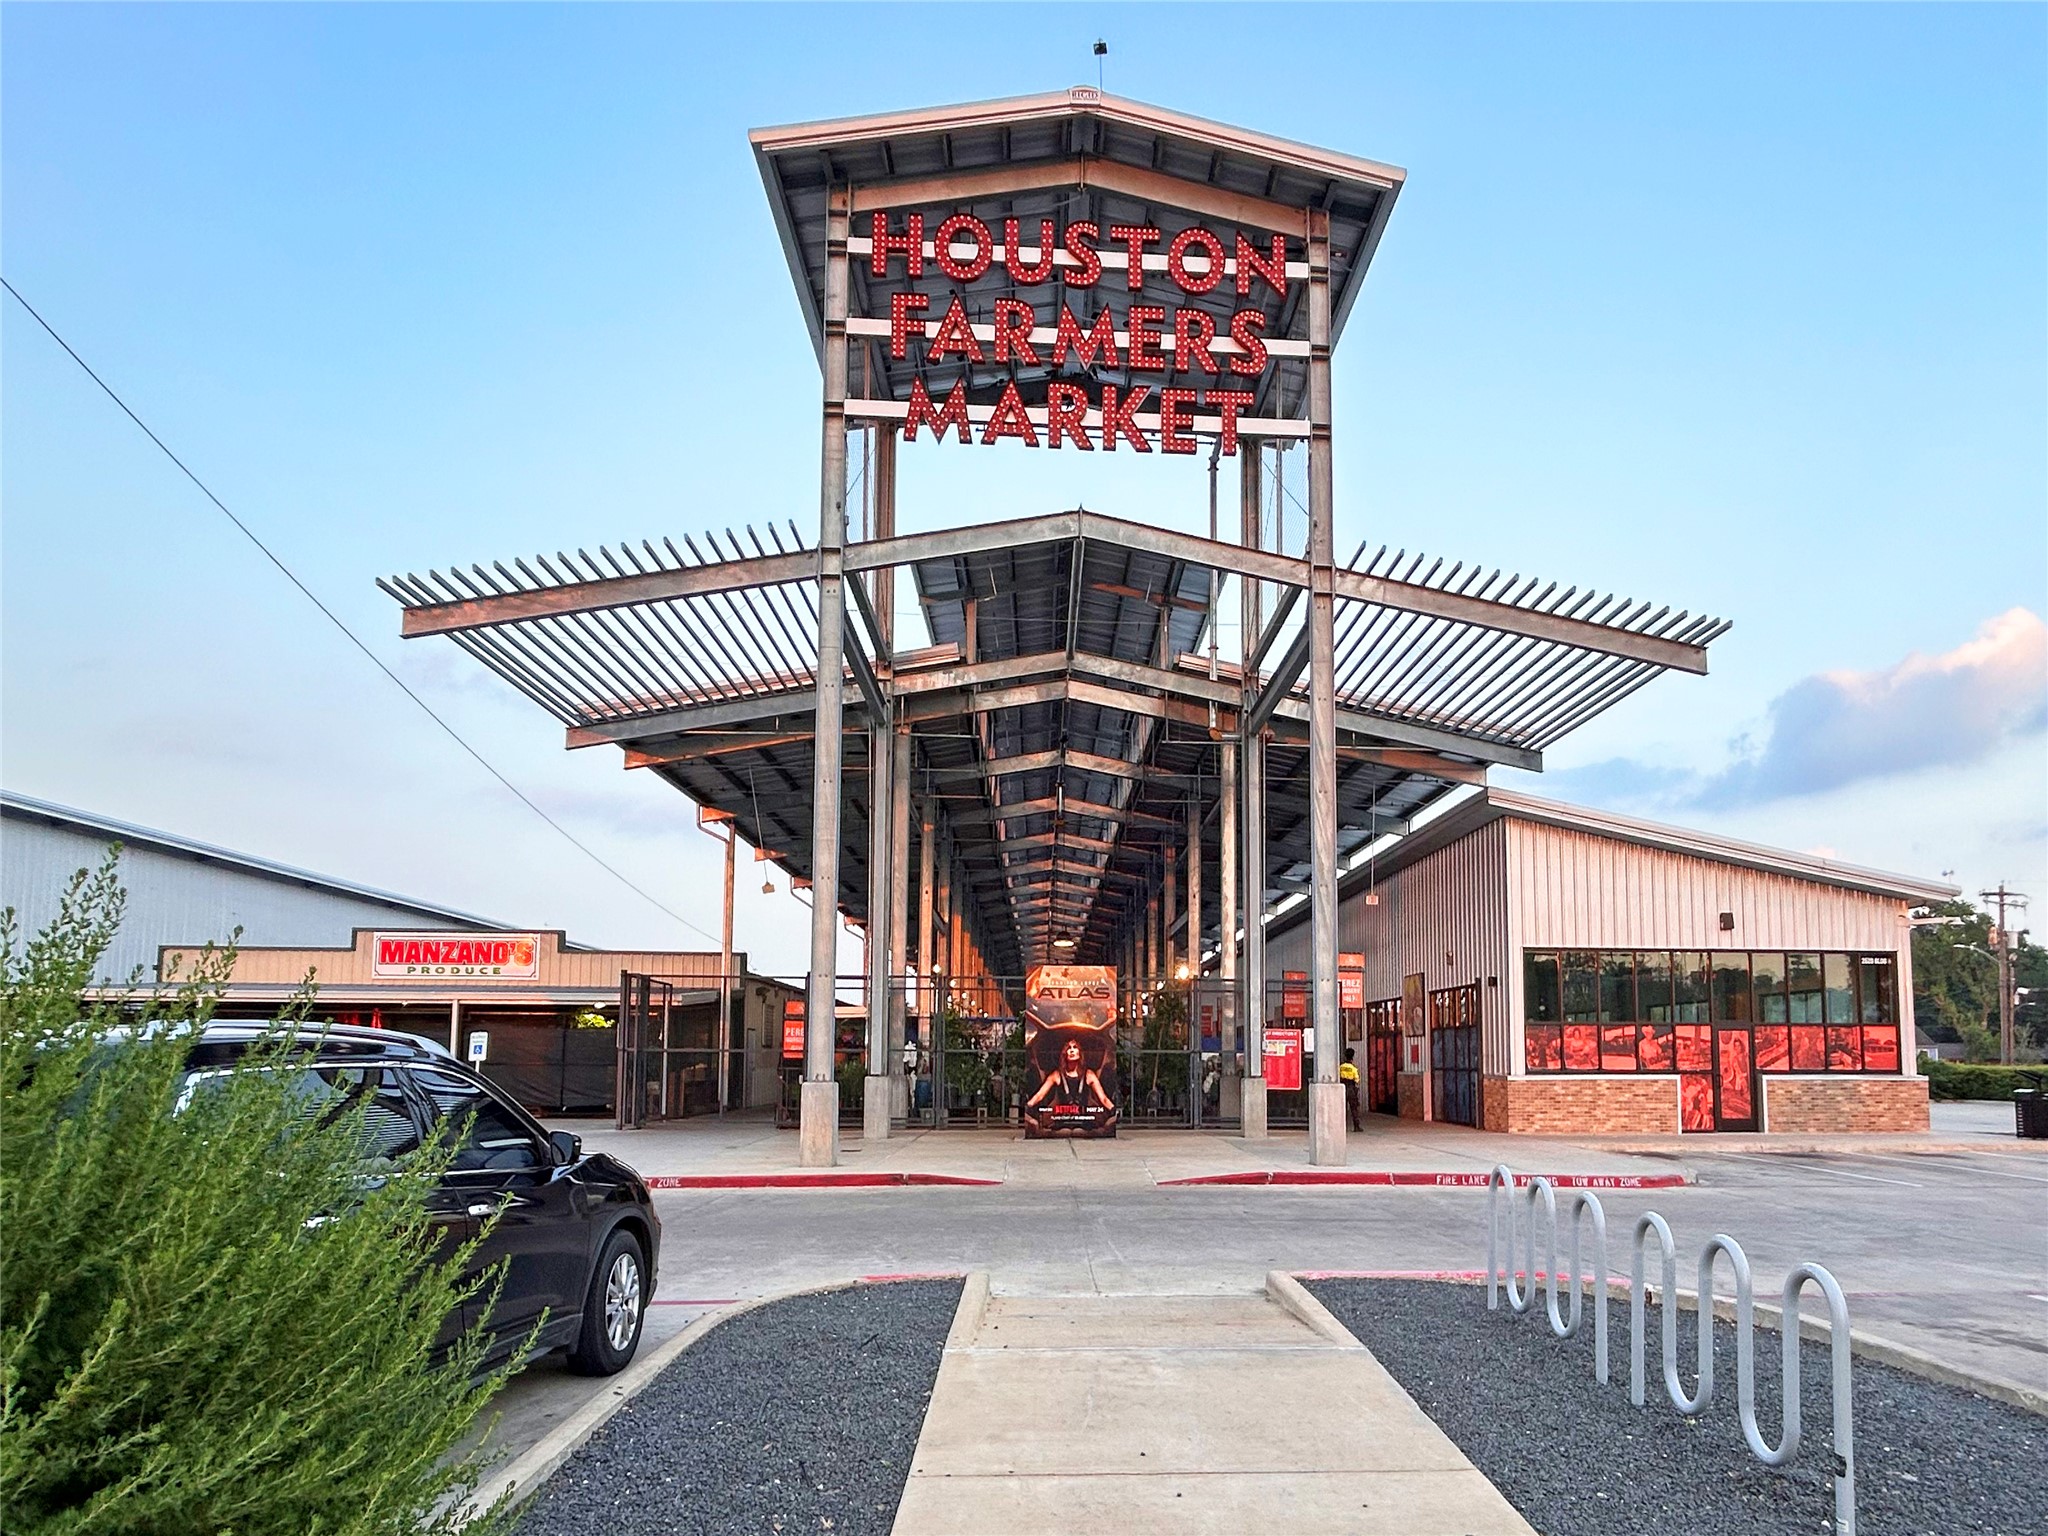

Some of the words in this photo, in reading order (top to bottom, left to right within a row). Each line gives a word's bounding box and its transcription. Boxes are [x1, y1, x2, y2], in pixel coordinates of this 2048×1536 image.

[871, 211, 1287, 301] HOUSTON
[891, 292, 1268, 377] FARMERS
[904, 377, 1255, 457] MARKET
[379, 939, 535, 966] MANZANO'S
[407, 966, 502, 975] PRODUCE
[1338, 979, 1361, 987] EREZ
[1038, 987, 1111, 999] ATLAS
[785, 1027, 804, 1037] PERE
[657, 1177, 682, 1188] ZONE
[1436, 1175, 1458, 1185] FIRE
[1462, 1175, 1486, 1186] LANE
[1572, 1176, 1589, 1187] TOW
[1592, 1177, 1615, 1187] AWAY
[1619, 1177, 1642, 1187] ZONE
